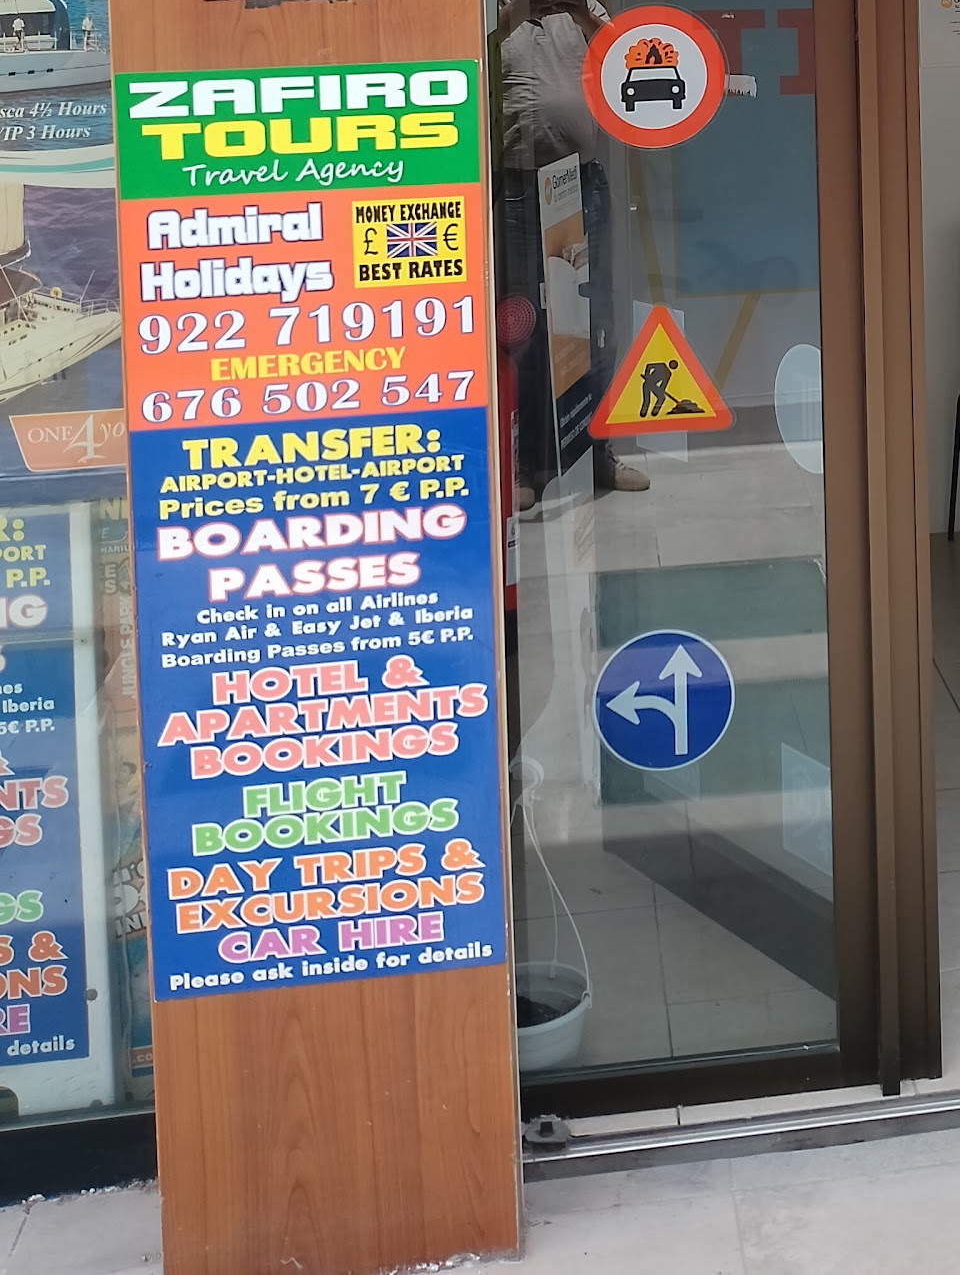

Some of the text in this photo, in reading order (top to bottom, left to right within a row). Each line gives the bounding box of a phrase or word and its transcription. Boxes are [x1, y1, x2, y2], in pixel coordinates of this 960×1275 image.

[58, 101, 107, 116] Hours
[129, 70, 468, 119] ZAFIRO
[26, 125, 36, 140] 3
[41, 125, 91, 139] Hours
[142, 112, 458, 160] TOURS
[182, 158, 404, 187] Travel Agency
[147, 201, 323, 250] Admiral
[356, 201, 461, 223] MONEY EXCHANGE
[140, 257, 334, 303] Holidays
[360, 259, 463, 281] BEST RATES
[138, 295, 474, 355] 922 719191
[211, 346, 406, 381] EMERGENCY
[141, 370, 476, 423] 676 502 547
[182, 424, 442, 470] TRANSFER:
[160, 454, 465, 493] AIRPORT-HOTEL-AIRPORT
[159, 476, 469, 520] Prices from 7 € P.P.
[0, 545, 46, 562] ORT
[157, 504, 467, 561] BOARDING
[6, 567, 50, 588] P.P.
[208, 552, 420, 602] PASSES
[161, 606, 473, 649] Ryan Air & Easy Jet & Iberia
[197, 592, 438, 625] Check in on all Airlines
[161, 627, 474, 669] Boarding Passes from 5€ P.P.
[212, 655, 430, 706] HOTEL &
[2, 696, 55, 713] Iberia
[25, 718, 55, 733] P.P.
[157, 683, 488, 747] APARTMENTS
[190, 722, 459, 780] BOOKINGS
[243, 770, 407, 818] FLIGHT
[192, 798, 459, 856] BOOKINGS
[167, 838, 486, 900] DAY TRIPS &
[176, 872, 485, 934] EXCURSIONS
[28, 930, 69, 962] &
[218, 911, 444, 964] CAR HIRE
[0, 965, 68, 1000] NS
[170, 942, 493, 991] Please ask inside for details
[7, 1034, 75, 1056] details
